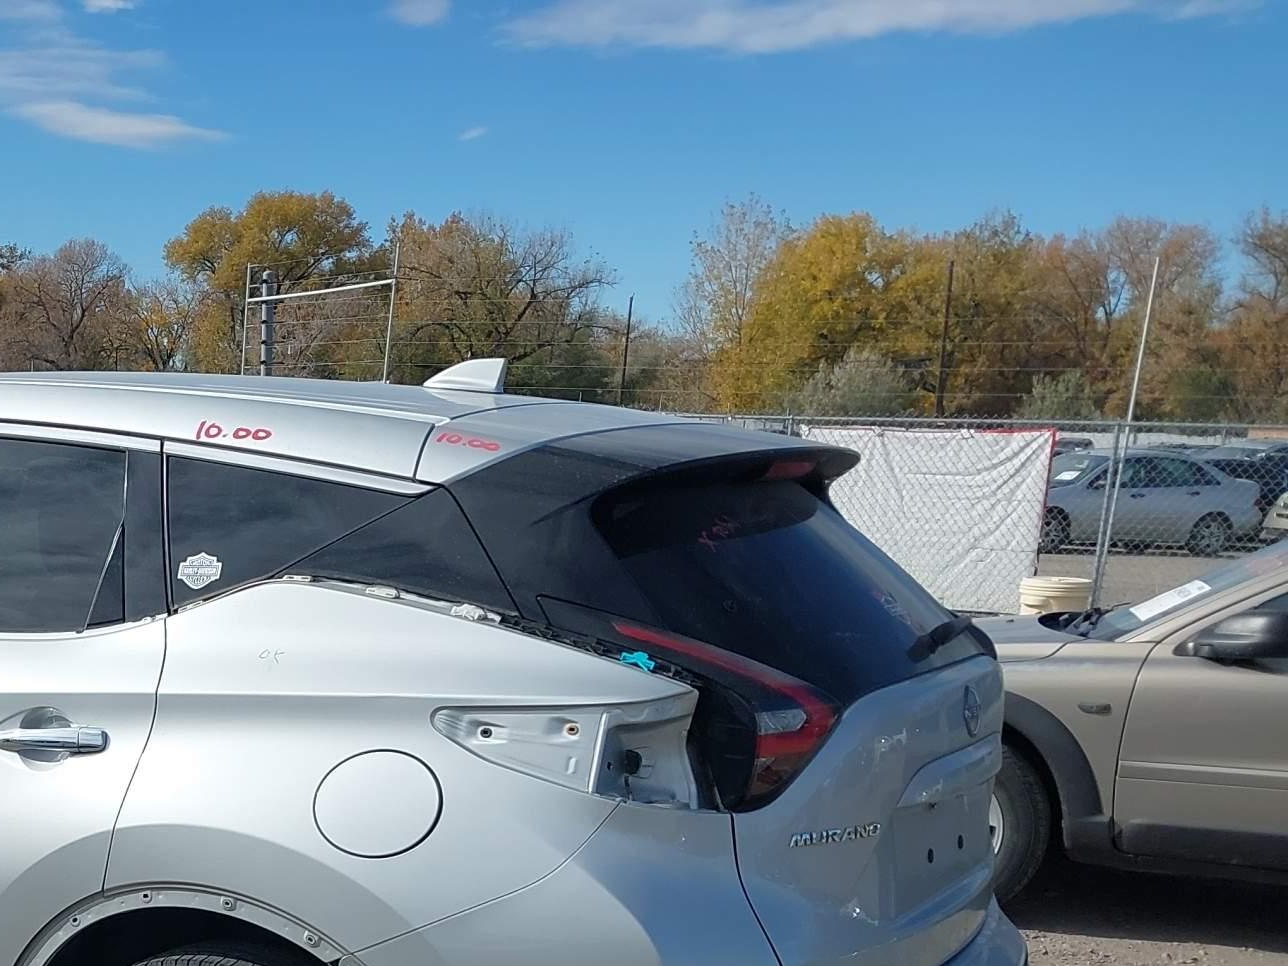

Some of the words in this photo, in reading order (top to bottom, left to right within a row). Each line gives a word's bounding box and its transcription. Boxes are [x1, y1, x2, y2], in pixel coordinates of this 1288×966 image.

[196, 420, 273, 441] 10.00
[436, 432, 501, 452] 10.00
[789, 823, 881, 848] MURANO
